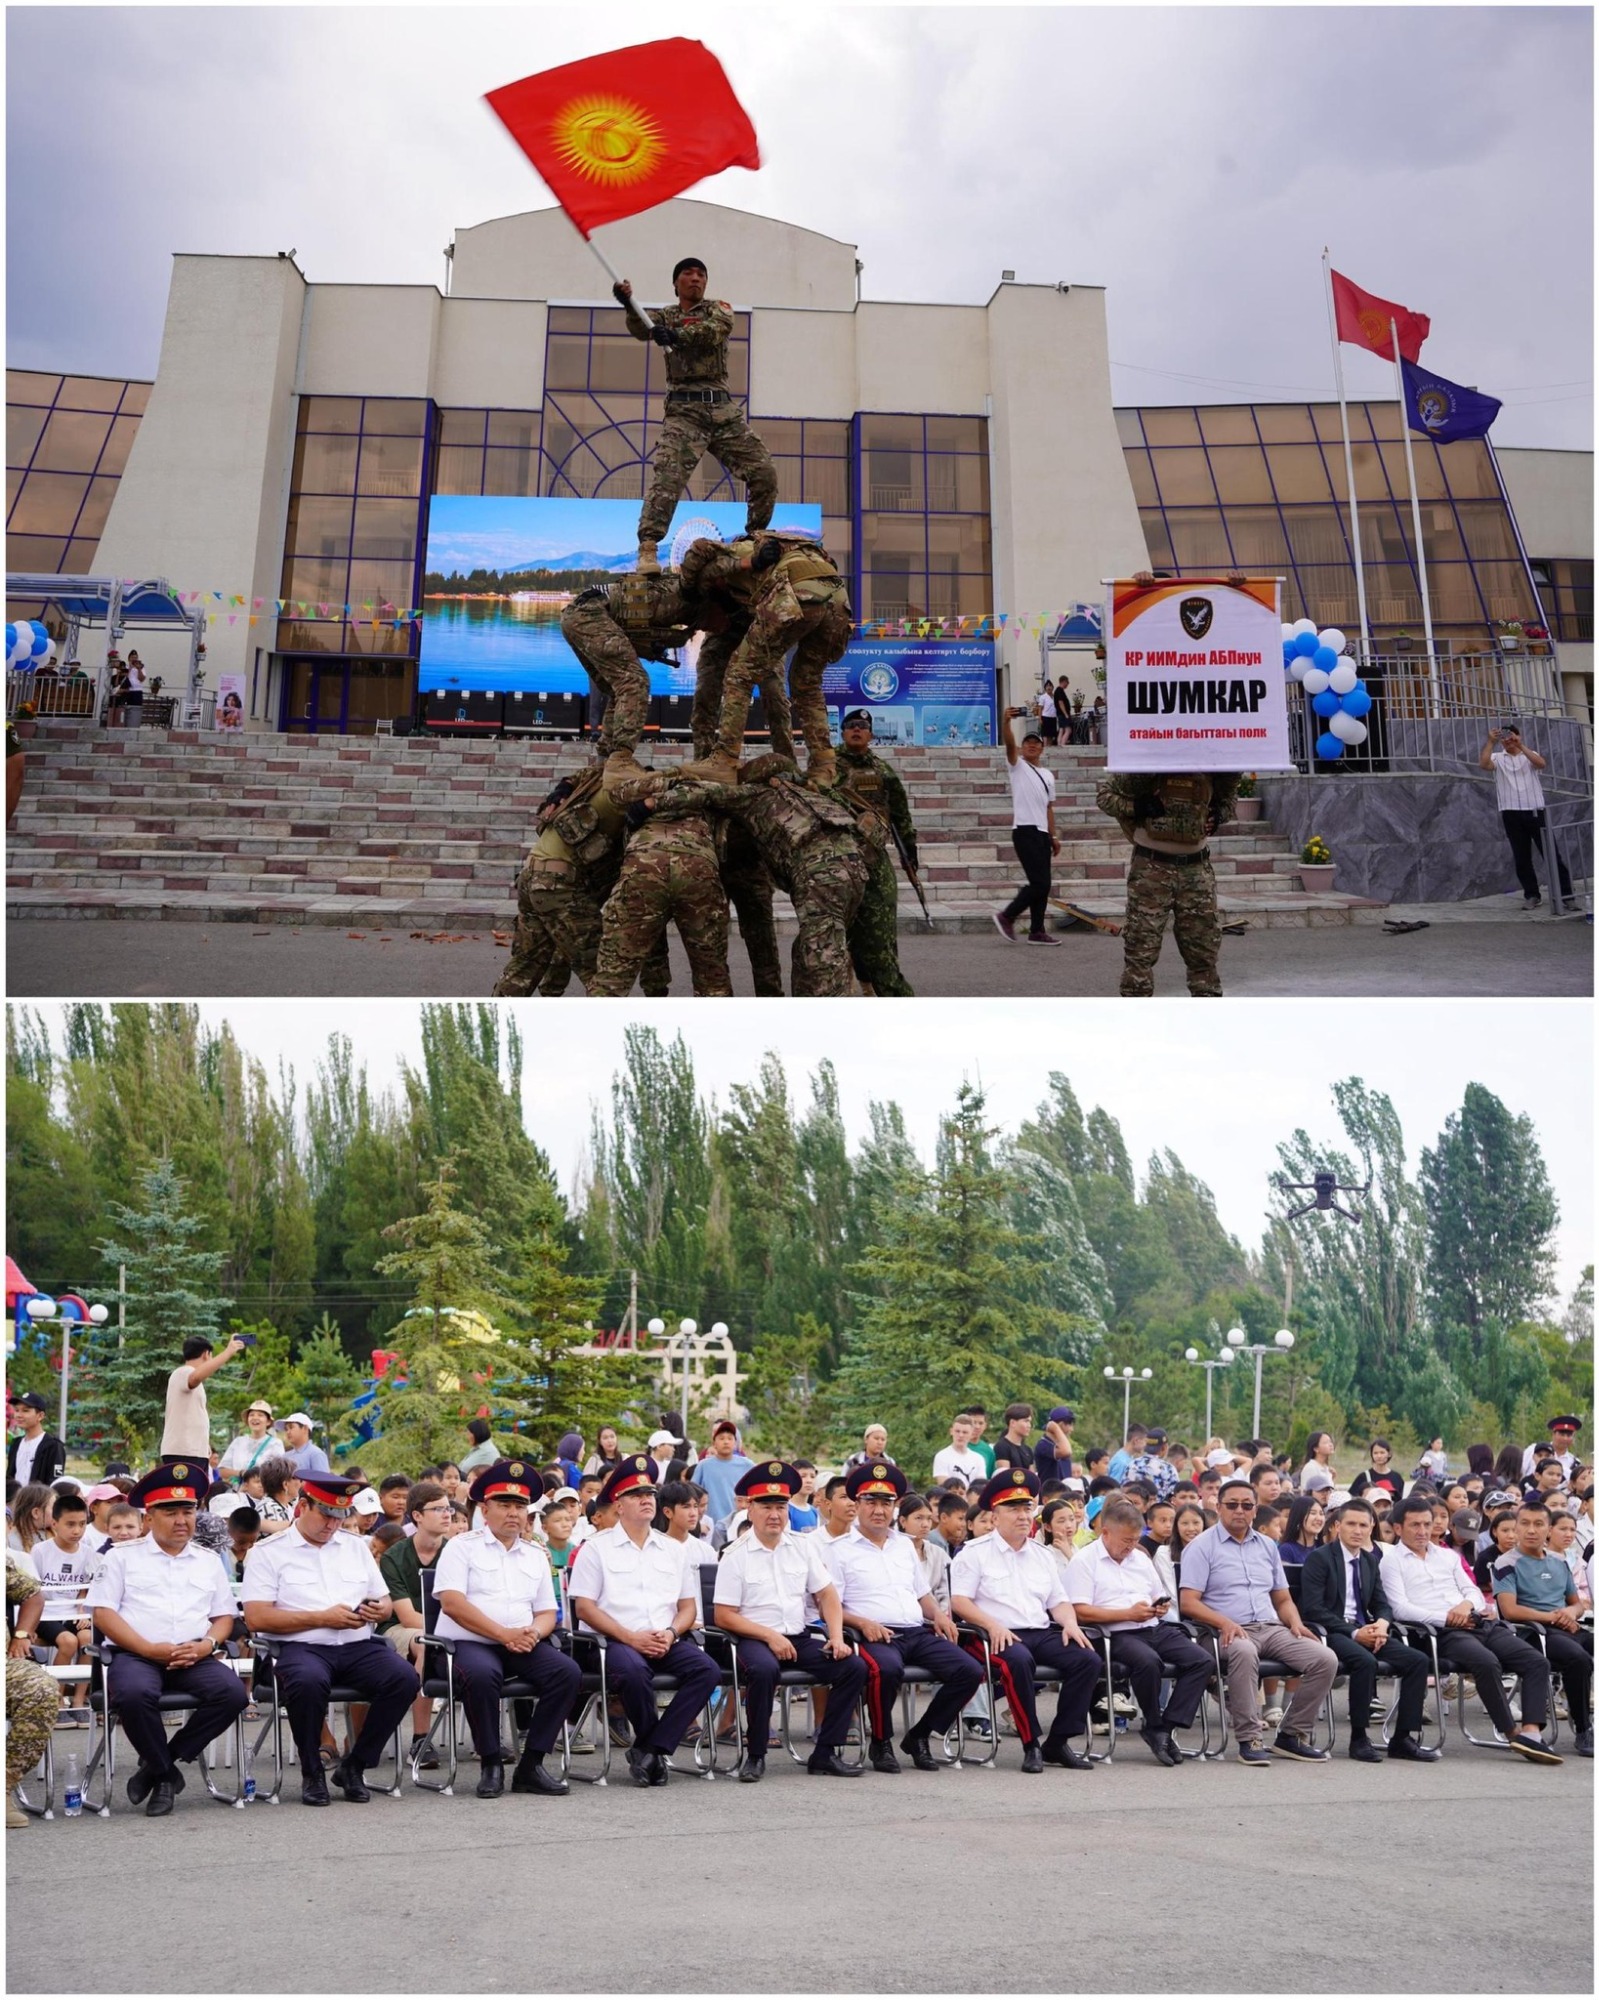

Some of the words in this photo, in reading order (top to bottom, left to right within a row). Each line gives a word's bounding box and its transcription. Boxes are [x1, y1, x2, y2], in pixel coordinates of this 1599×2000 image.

[959, 647, 991, 656] борбору
[1125, 651, 1143, 666] КР
[1146, 651, 1206, 668] ИИМдин
[1209, 650, 1261, 667] АБПнун
[1127, 680, 1267, 715] ШУМКАР
[1129, 728, 1174, 739] атайын
[1176, 728, 1237, 740] багыттагы
[1239, 728, 1267, 739] полк
[43, 1572, 84, 1583] ALWAYS
